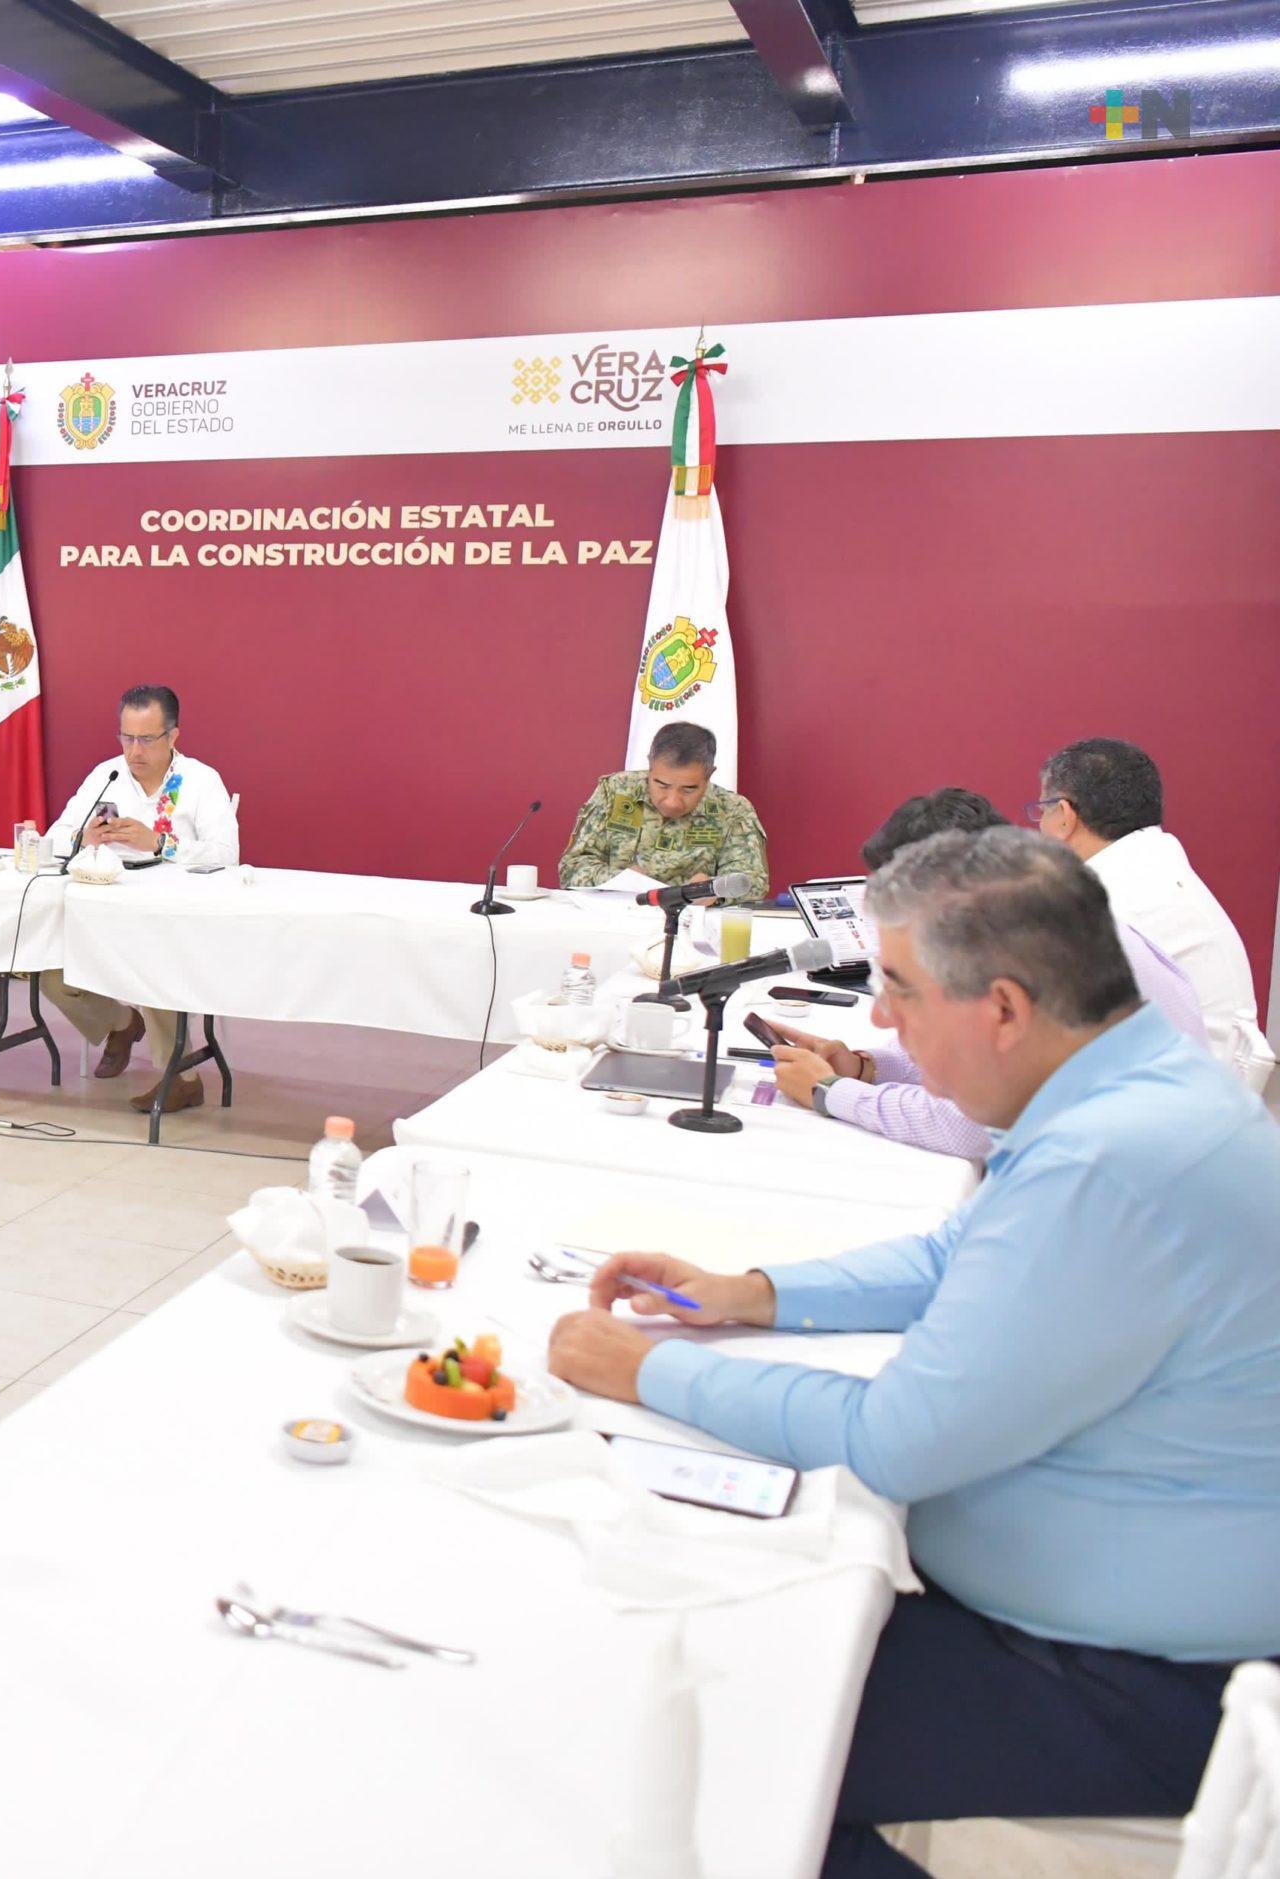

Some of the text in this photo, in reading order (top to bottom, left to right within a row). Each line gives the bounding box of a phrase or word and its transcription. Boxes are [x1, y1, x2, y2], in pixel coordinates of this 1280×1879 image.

[571, 343, 666, 378] VERA
[131, 380, 227, 398] VERACRUZ
[570, 377, 664, 412] CRUZ
[131, 398, 220, 418] GOBIERNO
[130, 416, 235, 435] DEL ESTADO
[508, 419, 663, 435] ME LLENA DE ORGULLO
[140, 500, 555, 532] COORDINACIÓN ESTATAL
[59, 535, 654, 567] PARA LA CONSTRUCCIÓN DE LA PAZ
